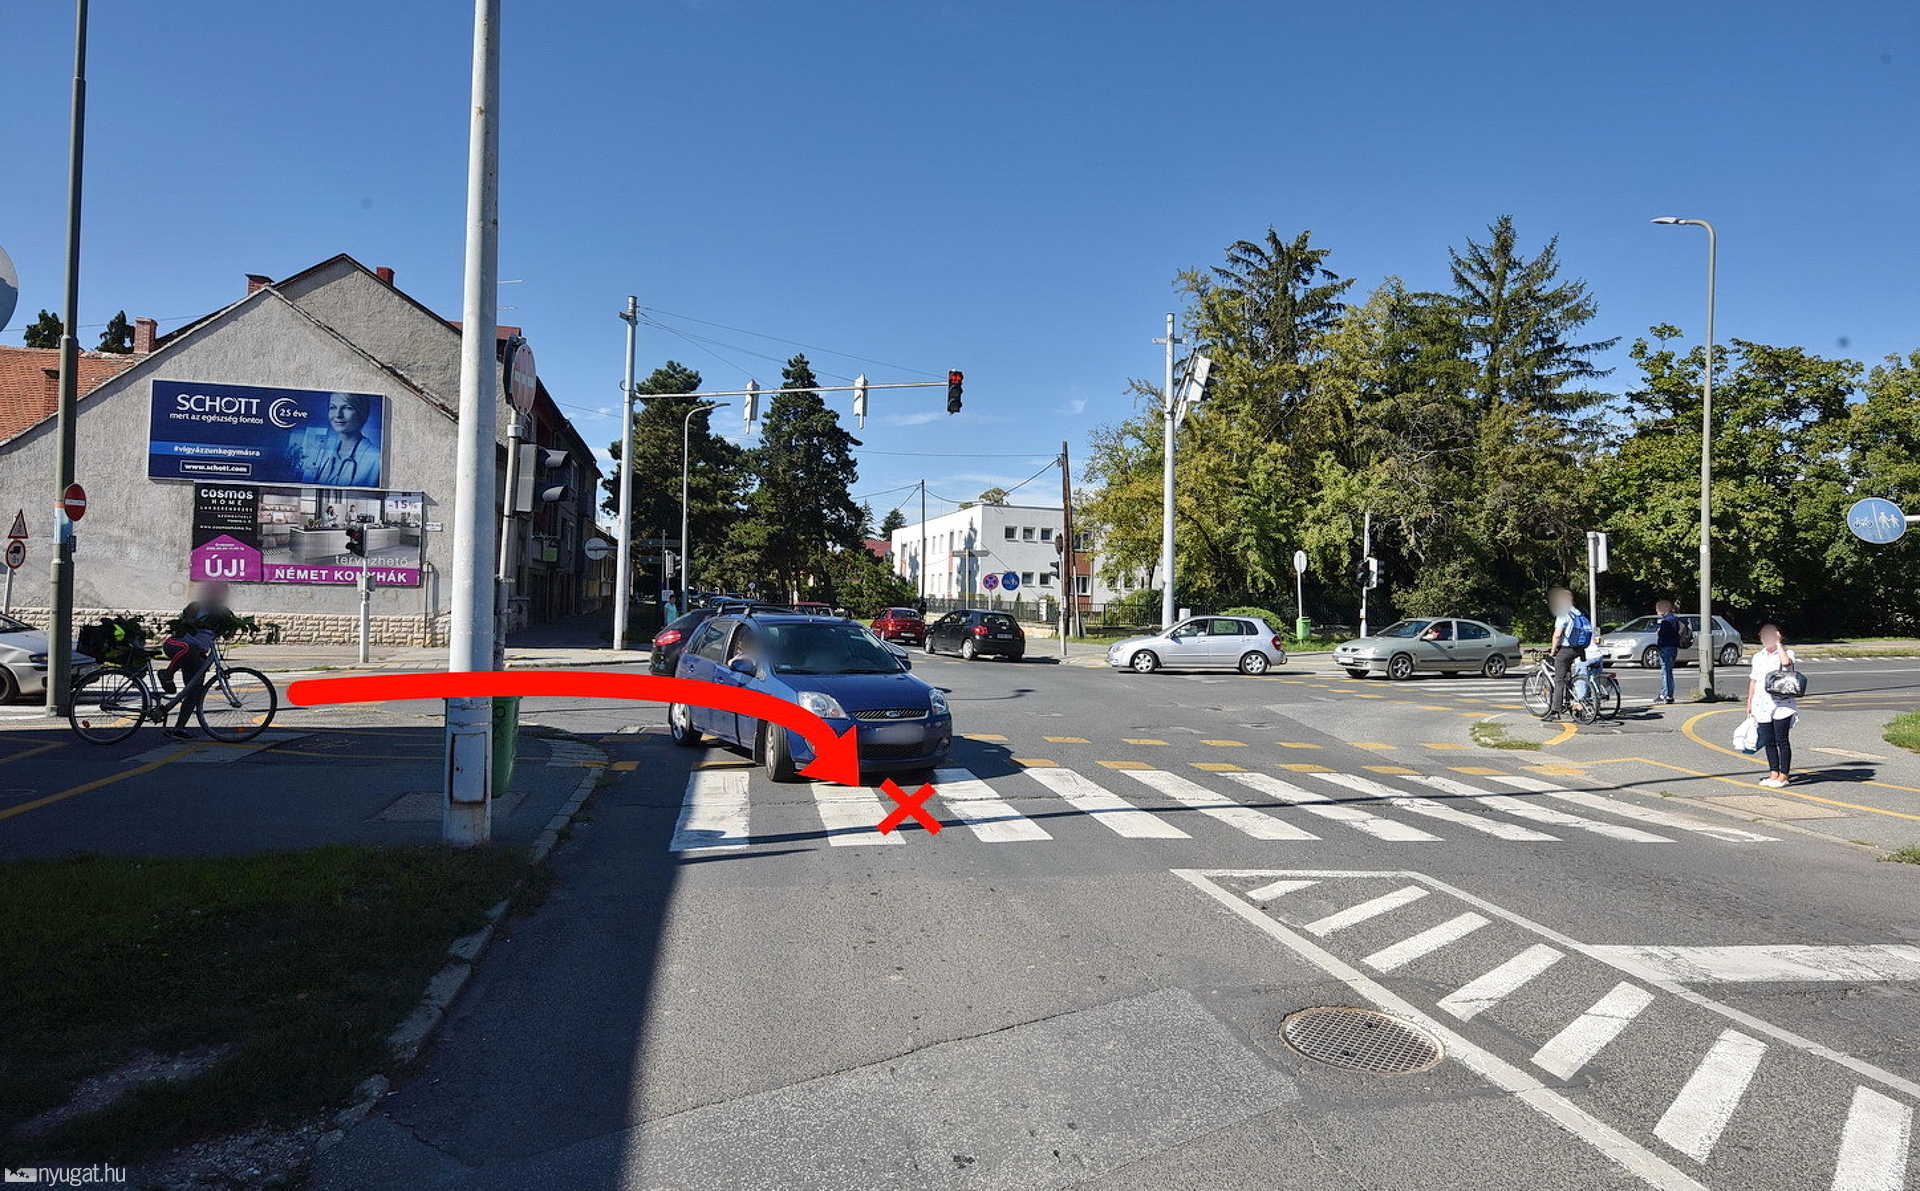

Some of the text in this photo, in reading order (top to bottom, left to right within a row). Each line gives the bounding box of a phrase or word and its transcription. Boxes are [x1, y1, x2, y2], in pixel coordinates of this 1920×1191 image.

[176, 394, 261, 415] SCHOTT
[169, 412, 190, 420] mert
[201, 415, 238, 425] egészség
[239, 416, 264, 425] fontos
[279, 408, 308, 418] 25 éve
[184, 463, 248, 473] www.schott.com
[200, 488, 254, 500] cosmos
[204, 554, 245, 577] ÚJ!
[275, 567, 328, 581] NÉMET
